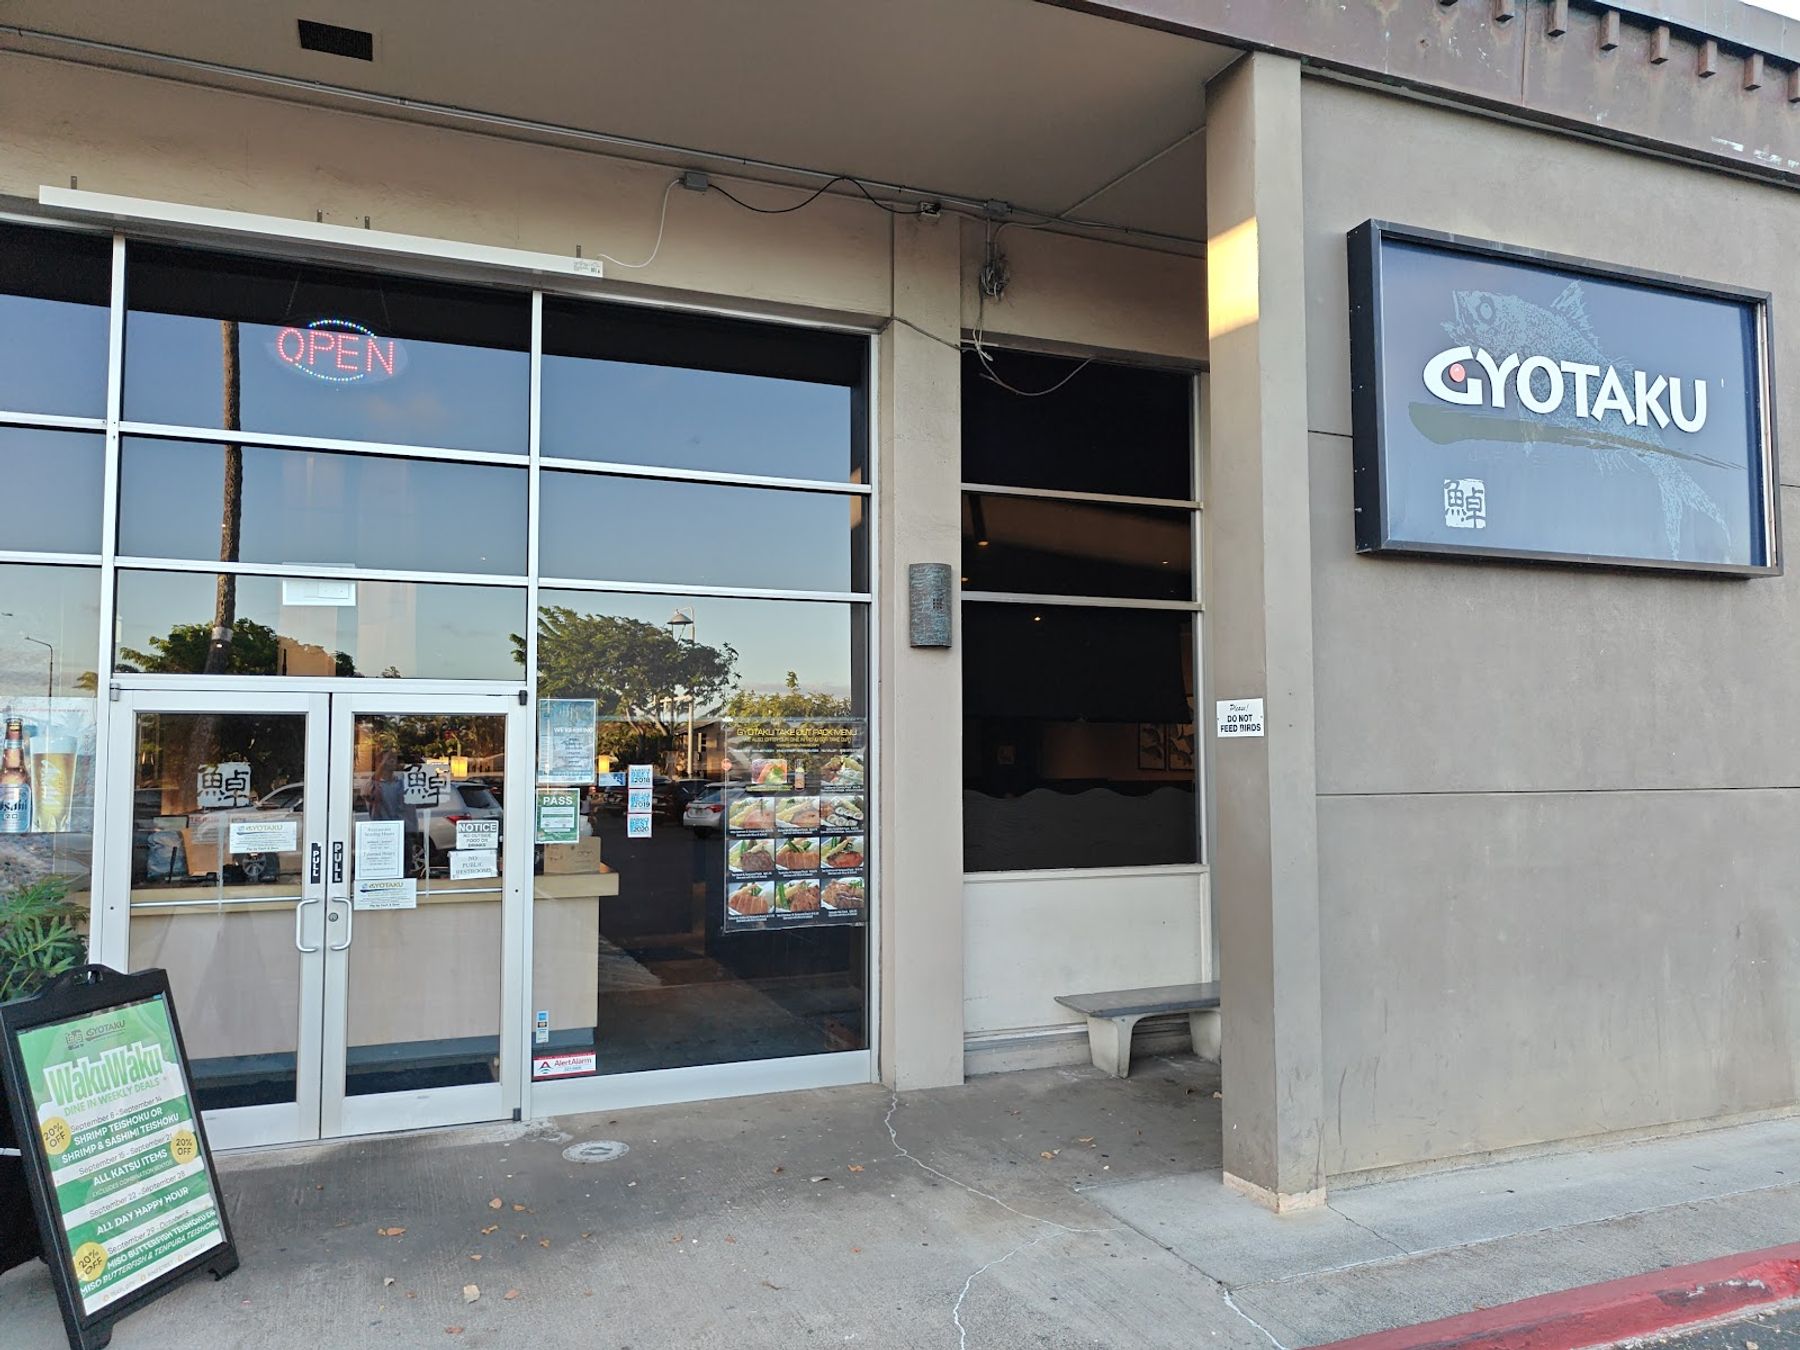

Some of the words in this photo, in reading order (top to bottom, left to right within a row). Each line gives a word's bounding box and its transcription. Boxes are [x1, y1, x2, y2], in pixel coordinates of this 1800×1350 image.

[278, 326, 395, 375] OPEN
[1423, 345, 1708, 434] GYOTAKU
[736, 727, 774, 736] GYOTAKU
[775, 727, 795, 736] TAKE
[796, 727, 812, 736] OUT
[812, 727, 834, 736] PACK
[834, 727, 858, 736] MENU
[1220, 724, 1238, 732] FEED
[1240, 723, 1262, 732] BIRDS
[1227, 714, 1238, 723] DO
[1238, 714, 1253, 722] NOT
[543, 796, 573, 806] PASS
[459, 823, 498, 832] NOTICE
[312, 850, 320, 876] PULL
[334, 844, 342, 882] PULL
[86, 1020, 126, 1036] GYOTAKU
[46, 1042, 164, 1107] WakuWaku
[64, 1102, 86, 1116] DINE
[87, 1098, 97, 1111] IN
[98, 1086, 132, 1105] WEEKLY
[134, 1078, 160, 1092] DEALS
[71, 1114, 109, 1132] September
[120, 1098, 154, 1114] September
[73, 1127, 108, 1146] SHRIMP
[108, 1110, 150, 1134] TEISHOKU
[150, 1107, 164, 1117] OR
[43, 1122, 63, 1141] 20%
[49, 1131, 66, 1148] OFF
[61, 1144, 97, 1164] SHRIMP
[97, 1142, 105, 1150] &
[105, 1130, 140, 1148] SASHIMI
[140, 1112, 180, 1134] TEISHOKU
[176, 1138, 192, 1146] 20%
[79, 1155, 118, 1176] September
[130, 1136, 165, 1154] September
[177, 1148, 192, 1156] OFF
[93, 1174, 112, 1187] ALL
[112, 1160, 141, 1178] KATSU
[140, 1148, 168, 1168] ITEMS
[88, 1196, 128, 1218] September
[128, 1192, 137, 1200] 22
[142, 1174, 176, 1195] September
[96, 1220, 114, 1236] ALL
[114, 1212, 134, 1228] DAY
[134, 1196, 164, 1218] HAPPY
[164, 1186, 190, 1204] HOUR
[107, 1254, 128, 1270] MISO
[128, 1230, 174, 1258] BUTTERFISH
[174, 1214, 206, 1236] TEISHOKU
[108, 1230, 146, 1254] September
[78, 1248, 100, 1269] 20%
[84, 1256, 103, 1275] OFF
[80, 1278, 102, 1298] MISO
[102, 1254, 148, 1284] BUTTERFISH
